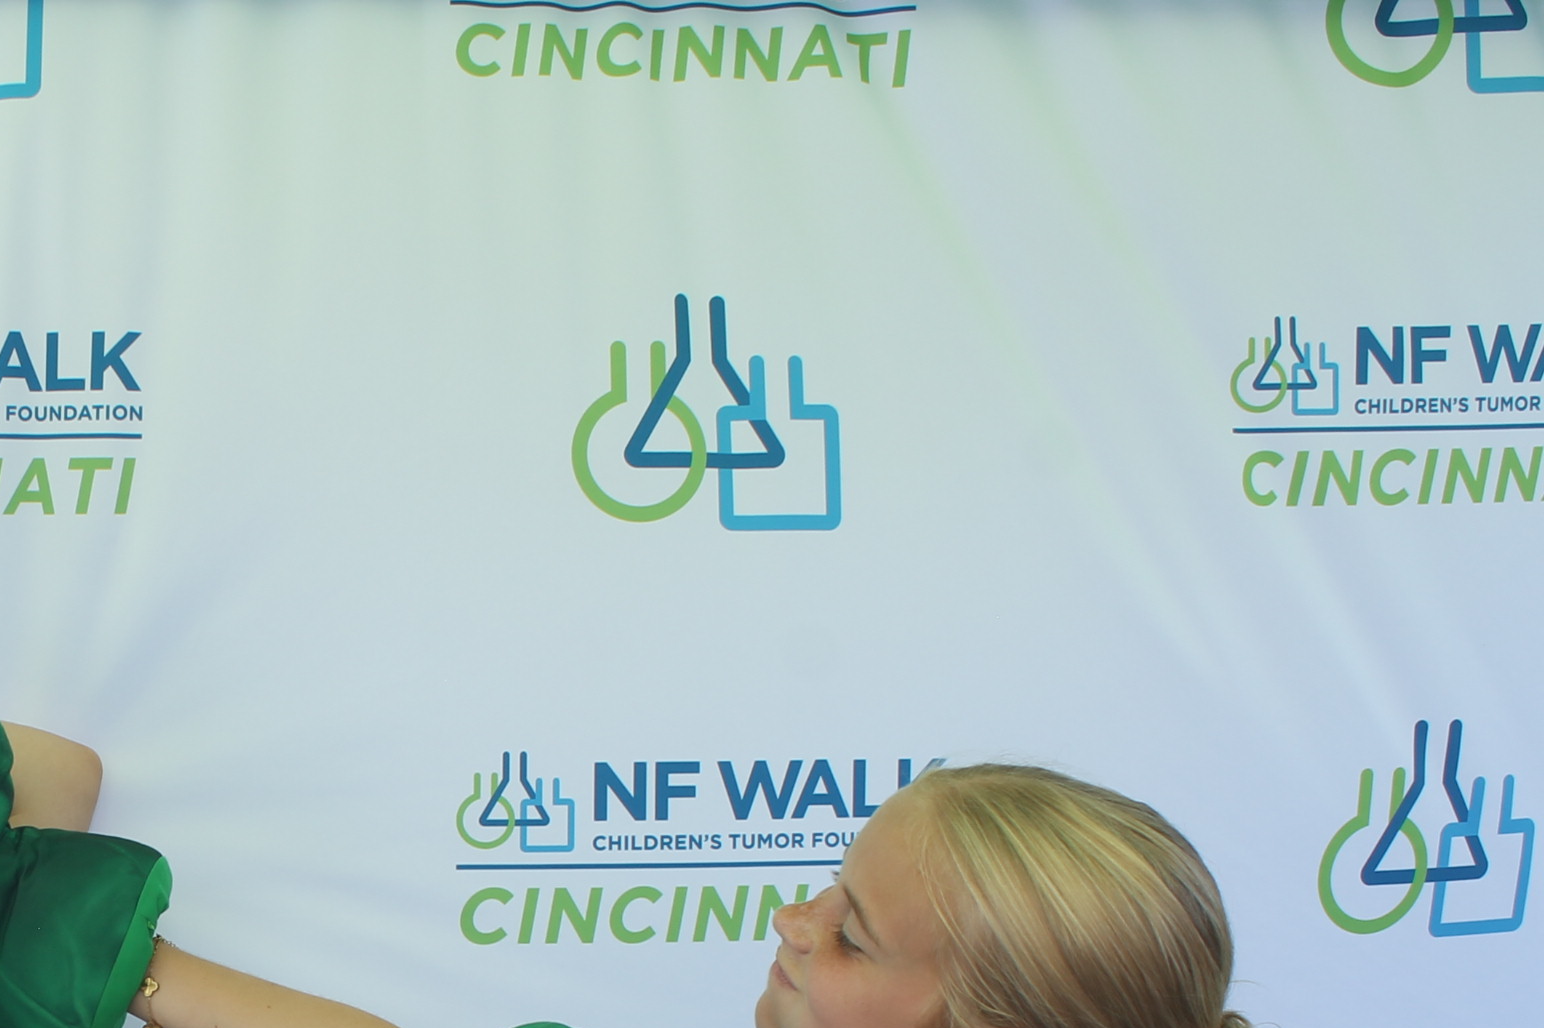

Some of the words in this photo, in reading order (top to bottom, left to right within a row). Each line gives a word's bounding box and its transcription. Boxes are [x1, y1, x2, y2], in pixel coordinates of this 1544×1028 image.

[456, 21, 912, 88] CINCINNATI
[1355, 325, 1452, 385] NF
[6, 404, 144, 423] FOUNDATION
[1354, 396, 1470, 415] CHILDREN'S
[1475, 395, 1541, 413] TUMOR
[1242, 446, 1544, 507] CINCINN
[593, 760, 701, 821] NF
[592, 833, 722, 852] CHILDREN'S
[728, 832, 805, 851] TUMOR
